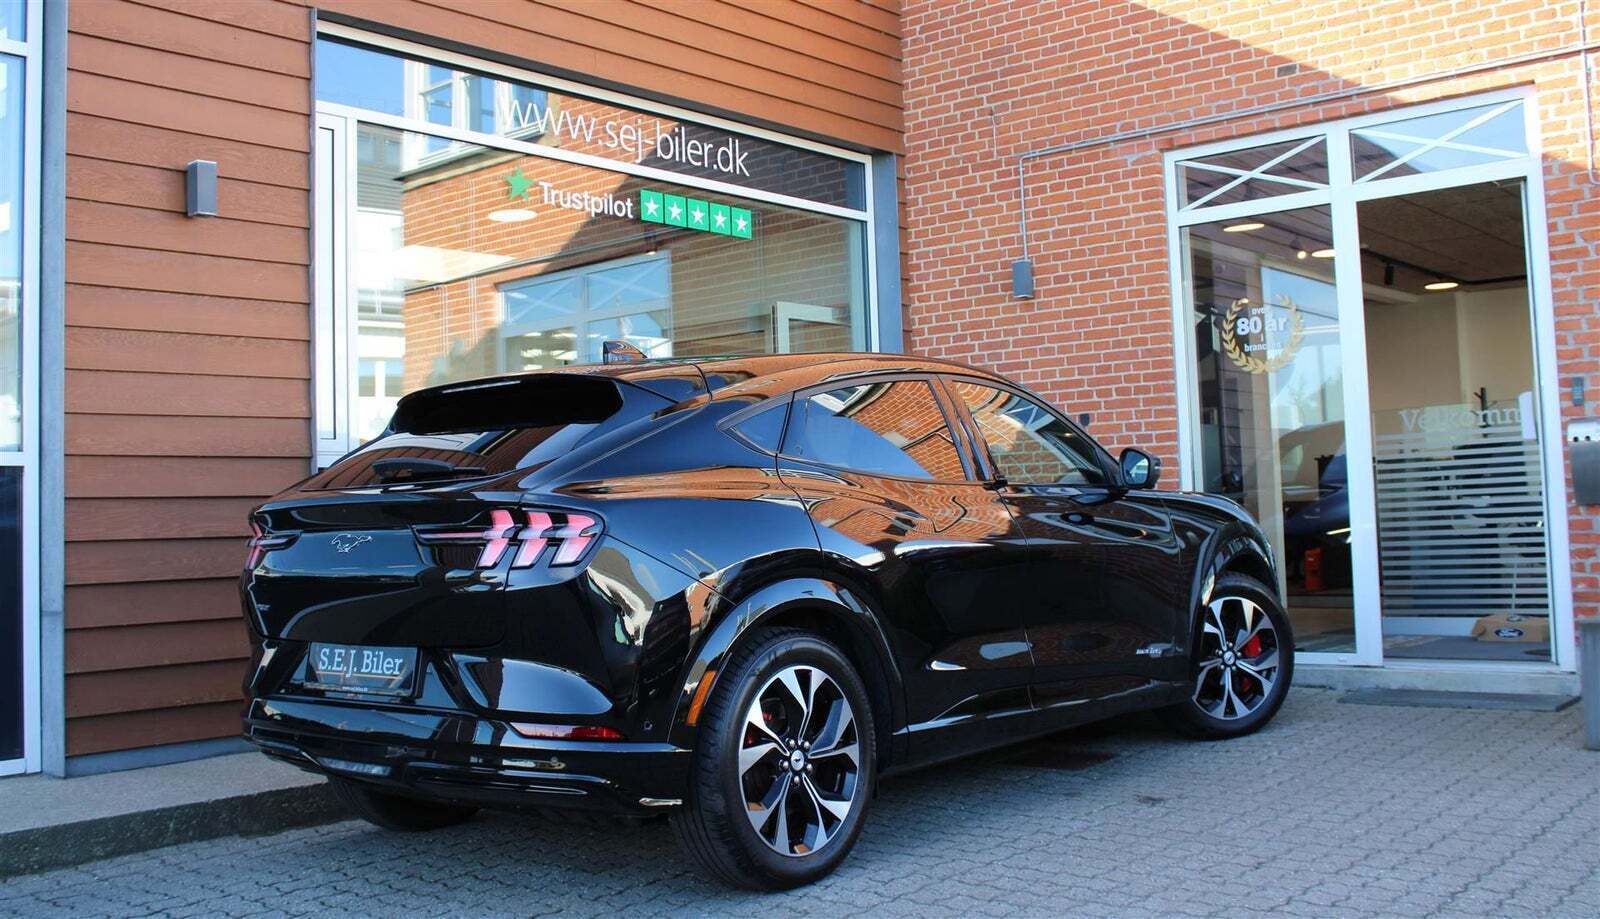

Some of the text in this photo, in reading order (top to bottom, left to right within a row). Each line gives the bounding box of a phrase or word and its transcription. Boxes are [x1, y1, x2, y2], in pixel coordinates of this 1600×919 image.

[501, 97, 750, 176] www.sej-biler.dk
[538, 181, 634, 218] Trustpilot
[1236, 316, 1262, 335] 80
[318, 647, 403, 678] S.E.J. Biler
